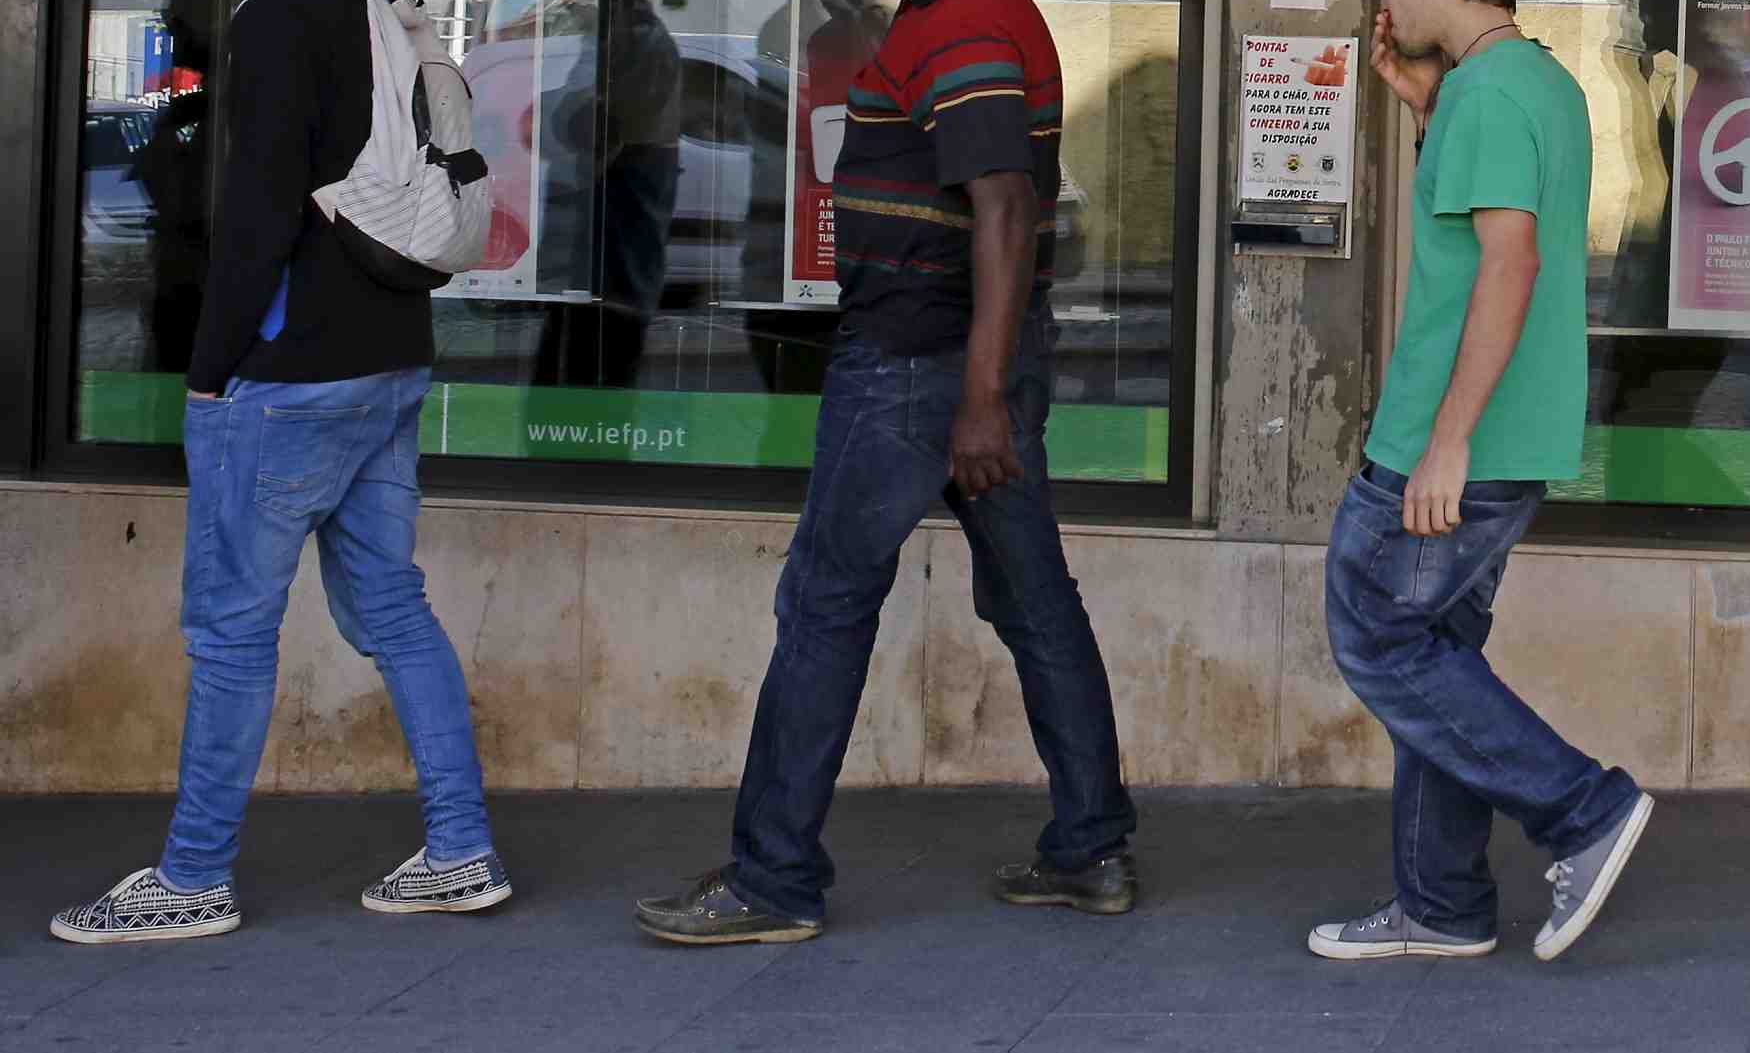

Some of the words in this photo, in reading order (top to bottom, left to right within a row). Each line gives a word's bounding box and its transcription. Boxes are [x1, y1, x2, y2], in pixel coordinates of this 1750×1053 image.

[1246, 41, 1288, 54] PONTAS
[1259, 58, 1275, 68] DE
[1245, 89, 1270, 100] PARA
[1273, 90, 1280, 100] O
[1282, 89, 1310, 101] CHÃO,
[1313, 88, 1340, 101] NÃO!
[1250, 104, 1282, 114] AGORA
[1285, 105, 1305, 115] TEM
[1308, 106, 1331, 116] ESTE
[1249, 118, 1301, 130] CINZEIRO
[1311, 122, 1330, 131] SUA
[1261, 133, 1318, 146] DISPOSIÇÃO
[1267, 188, 1319, 199] AGRADECE
[819, 199, 825, 208] A
[528, 422, 687, 452] www.iefp.pt
